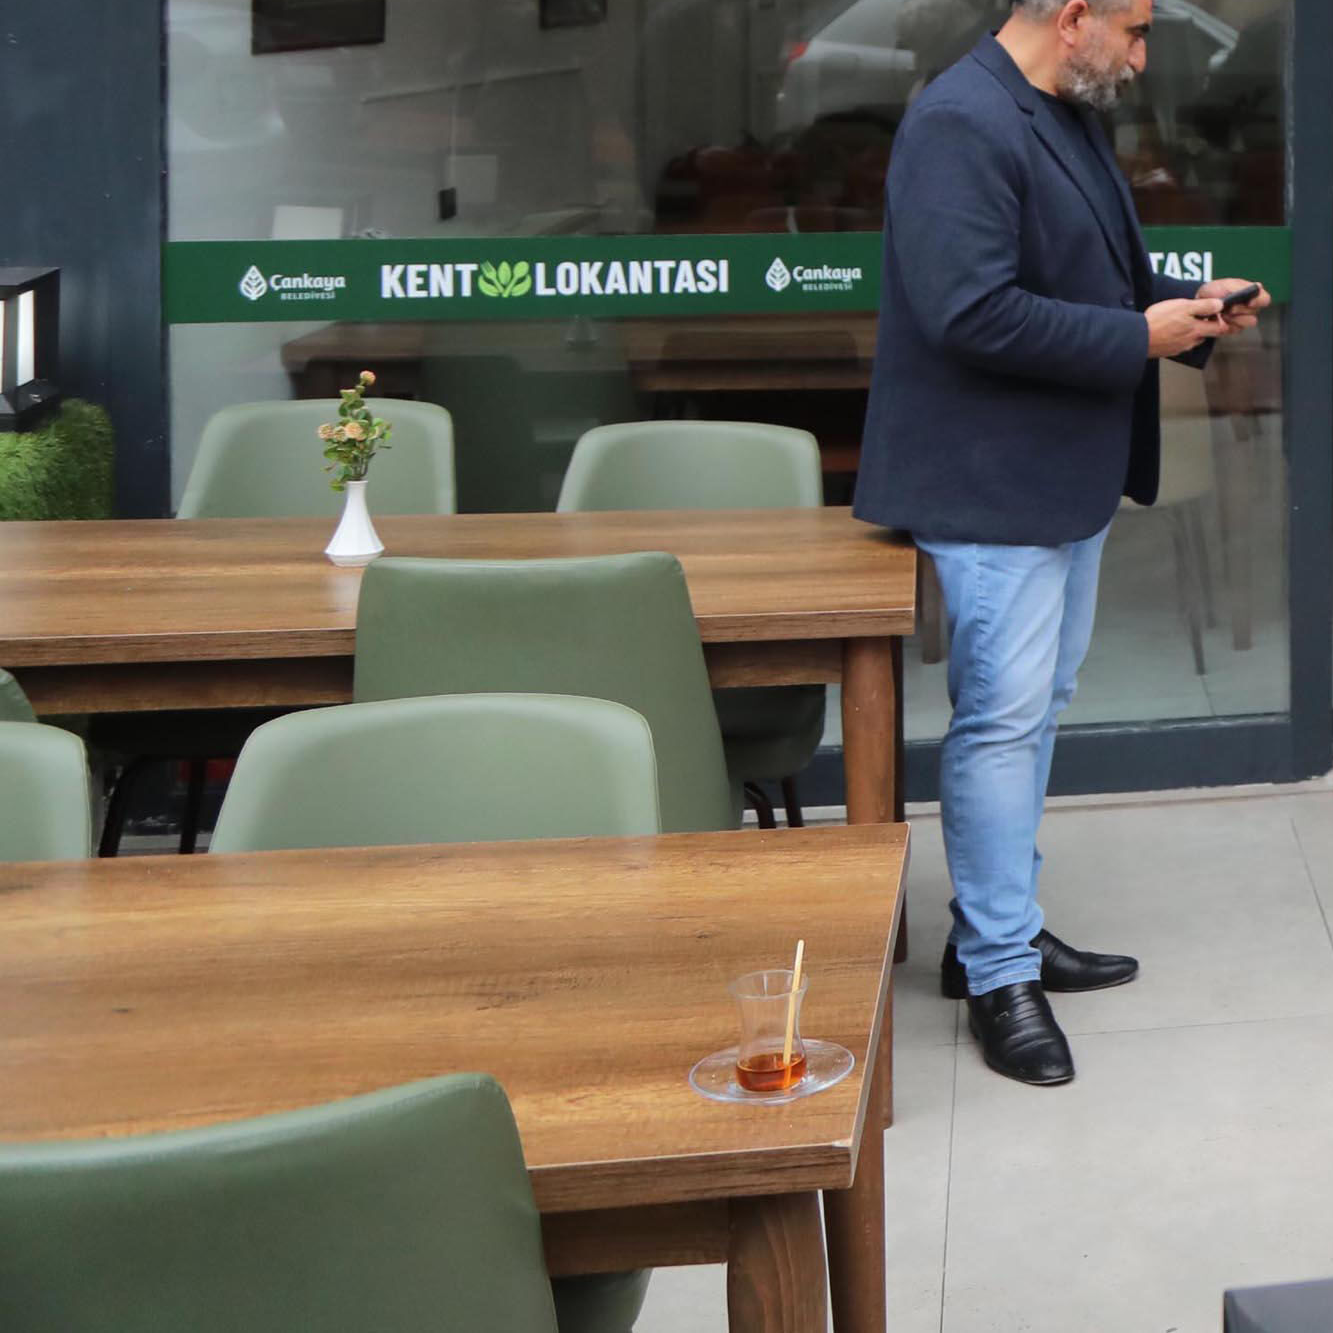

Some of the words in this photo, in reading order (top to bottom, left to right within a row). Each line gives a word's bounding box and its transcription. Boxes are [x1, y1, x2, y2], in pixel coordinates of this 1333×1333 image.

[269, 273, 347, 292] Çankaya
[381, 263, 478, 299] KENT
[535, 259, 730, 297] LOKANTASI
[792, 264, 863, 282] Çankaya
